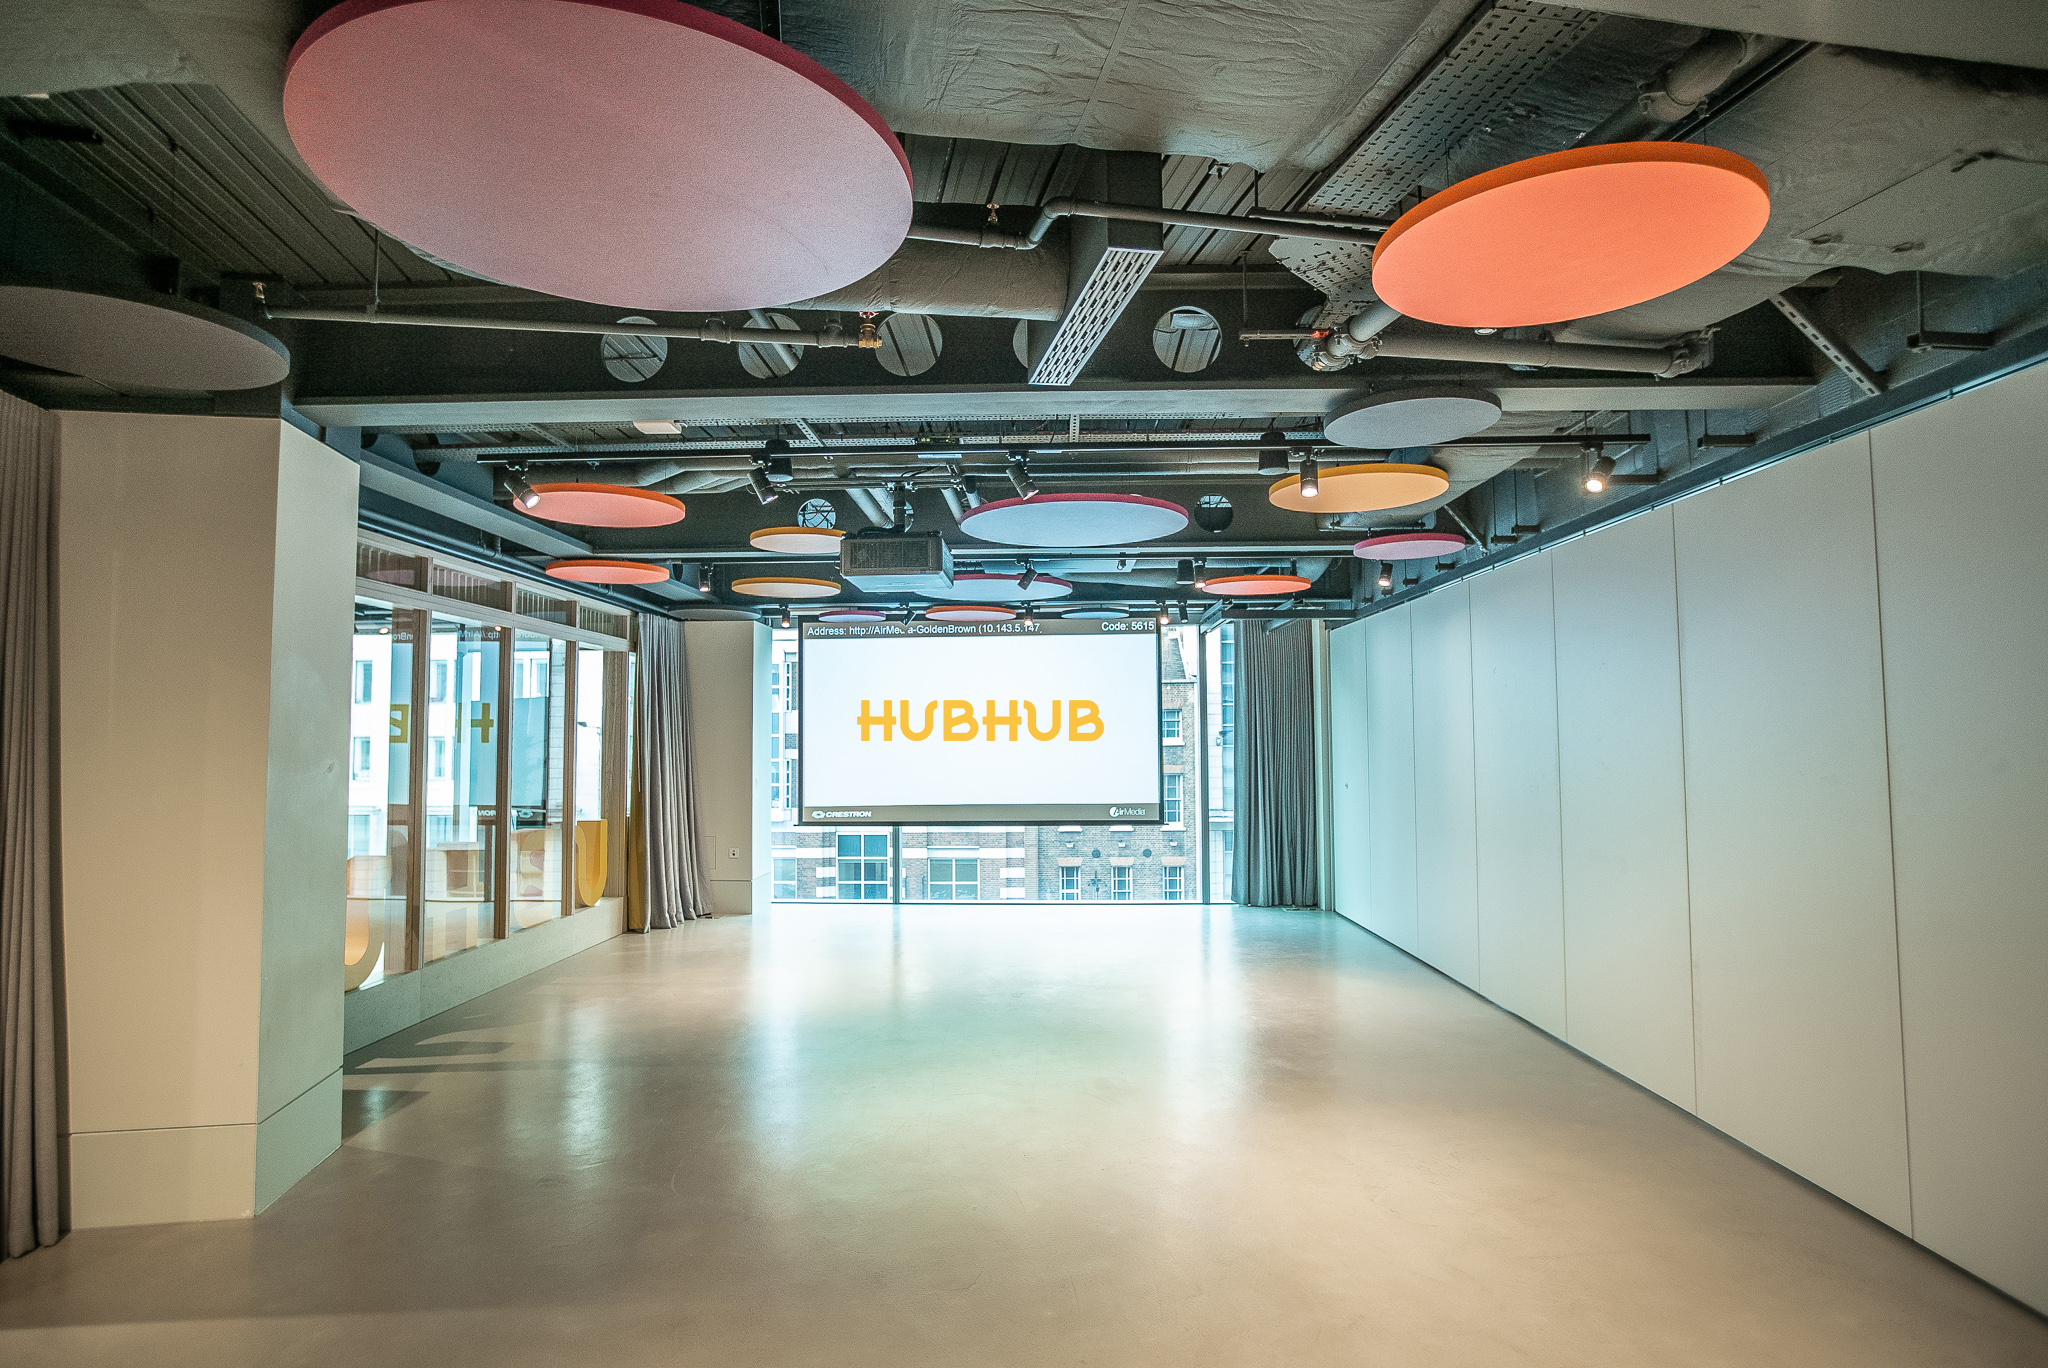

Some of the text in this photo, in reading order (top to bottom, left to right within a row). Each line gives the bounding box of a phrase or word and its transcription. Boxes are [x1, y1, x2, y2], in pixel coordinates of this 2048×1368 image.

[807, 623, 1043, 637] Address: http://AirMea-GoldenBrown (10.143.5.147
[1101, 621, 1155, 631] Code: 5615
[857, 700, 1104, 741] HUBHUB
